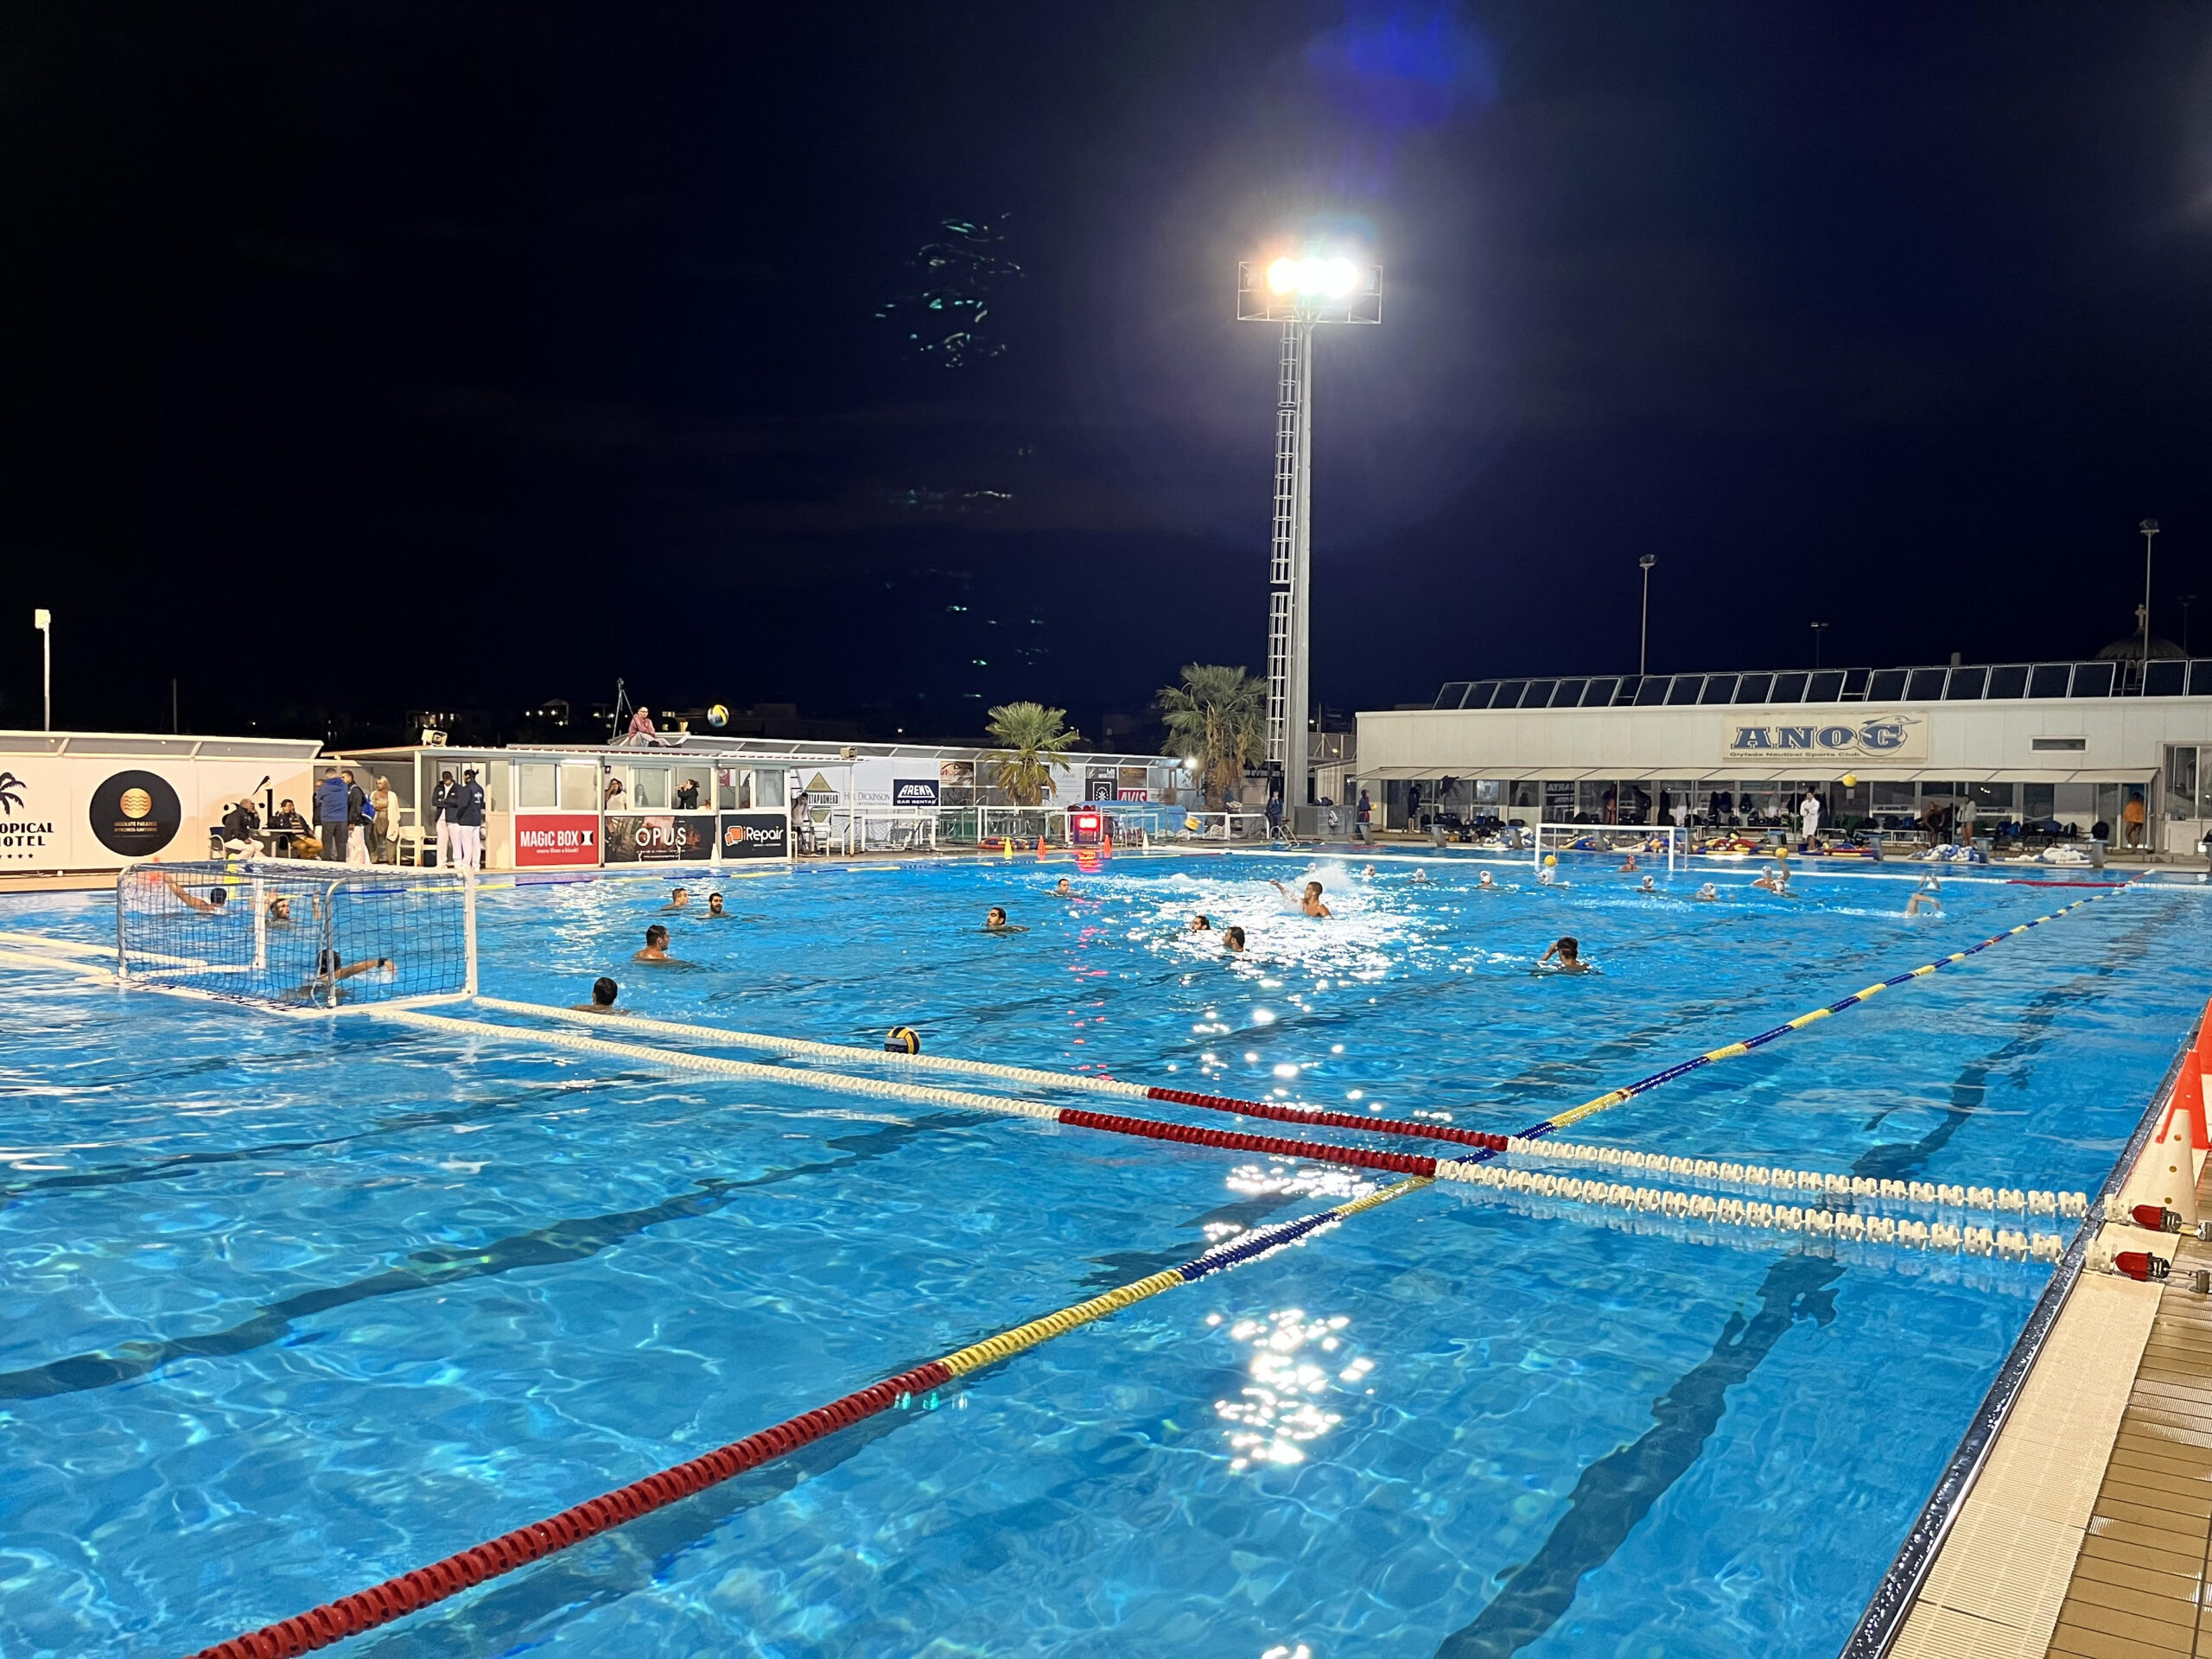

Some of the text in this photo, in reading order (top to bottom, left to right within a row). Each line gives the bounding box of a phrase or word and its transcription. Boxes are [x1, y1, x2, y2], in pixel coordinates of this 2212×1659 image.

[1731, 724, 1907, 749] ANOG
[858, 791, 890, 801] DICKINSON
[897, 785, 936, 798] ARENA
[1121, 791, 1147, 802] AVIS
[557, 830, 579, 846] BOX
[635, 827, 687, 847] OPUS
[743, 825, 784, 843] iRepair
[0, 836, 46, 847] OTEL
